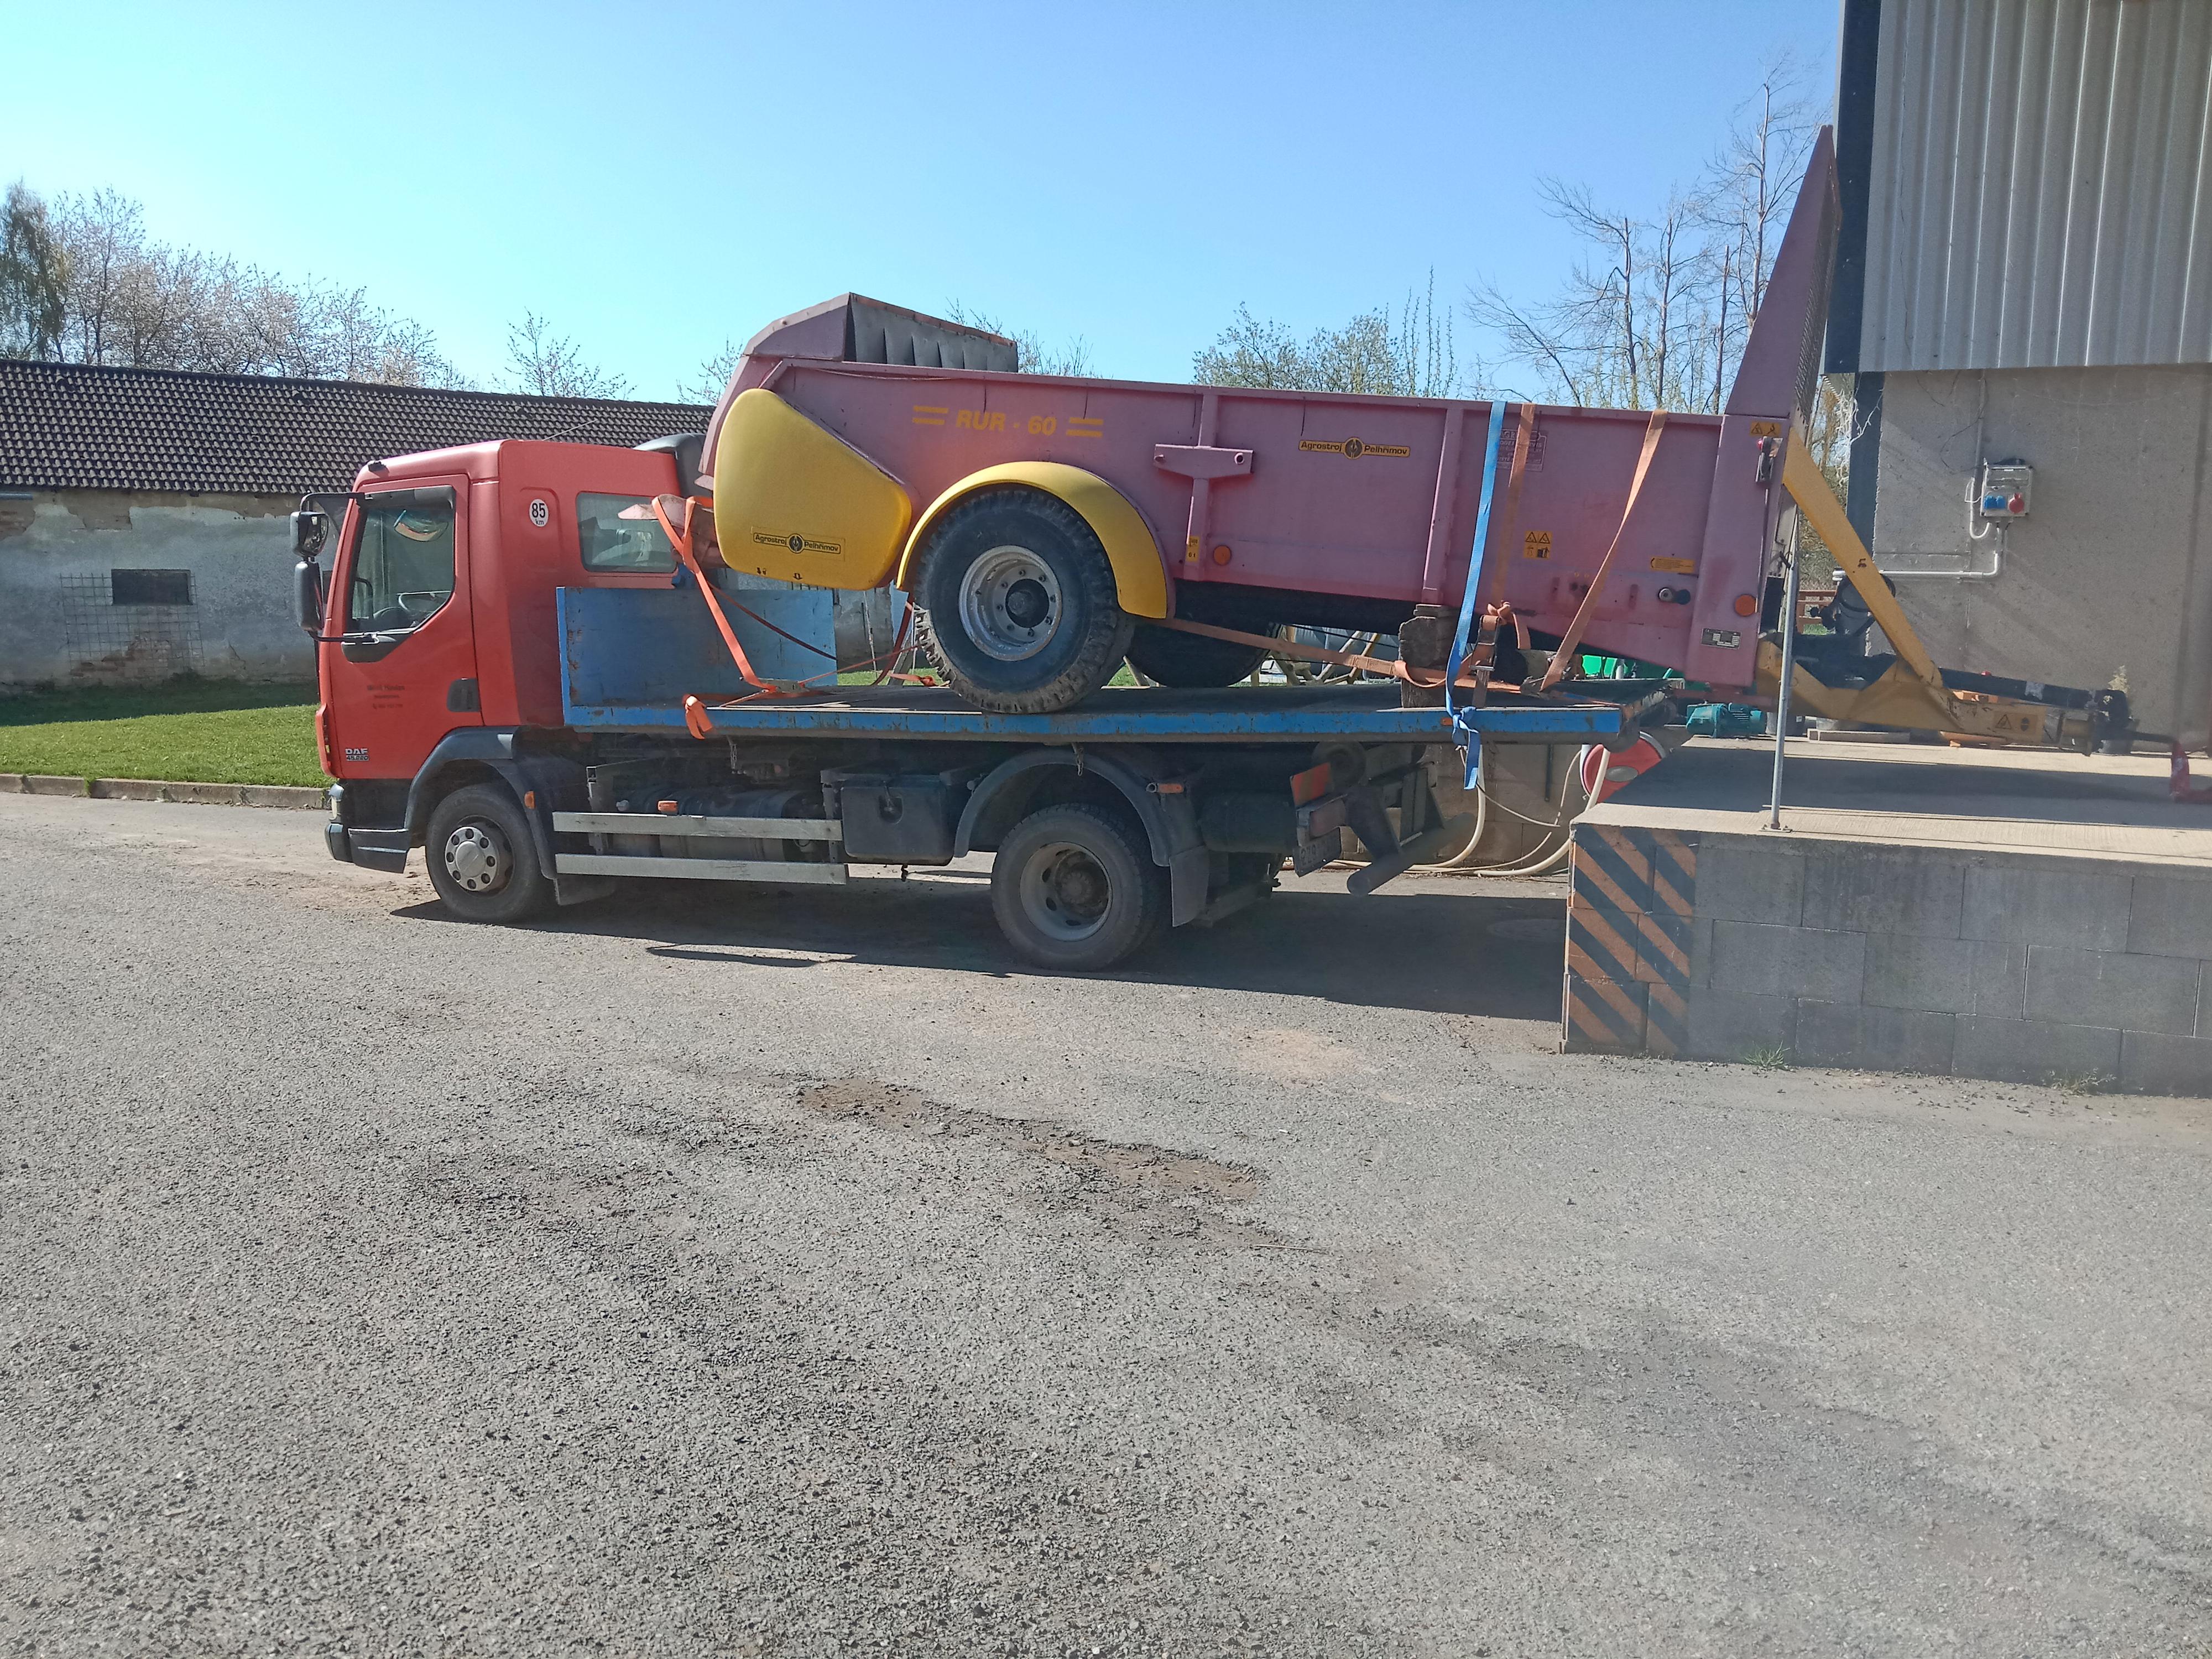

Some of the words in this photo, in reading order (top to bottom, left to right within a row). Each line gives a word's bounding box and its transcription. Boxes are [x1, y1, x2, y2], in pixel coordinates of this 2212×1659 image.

[956, 409, 1006, 432] RUR
[1027, 415, 1057, 436] 60
[1301, 441, 1342, 452] Agrostroj
[531, 502, 546, 518] 85
[755, 534, 787, 546] Agrostroj
